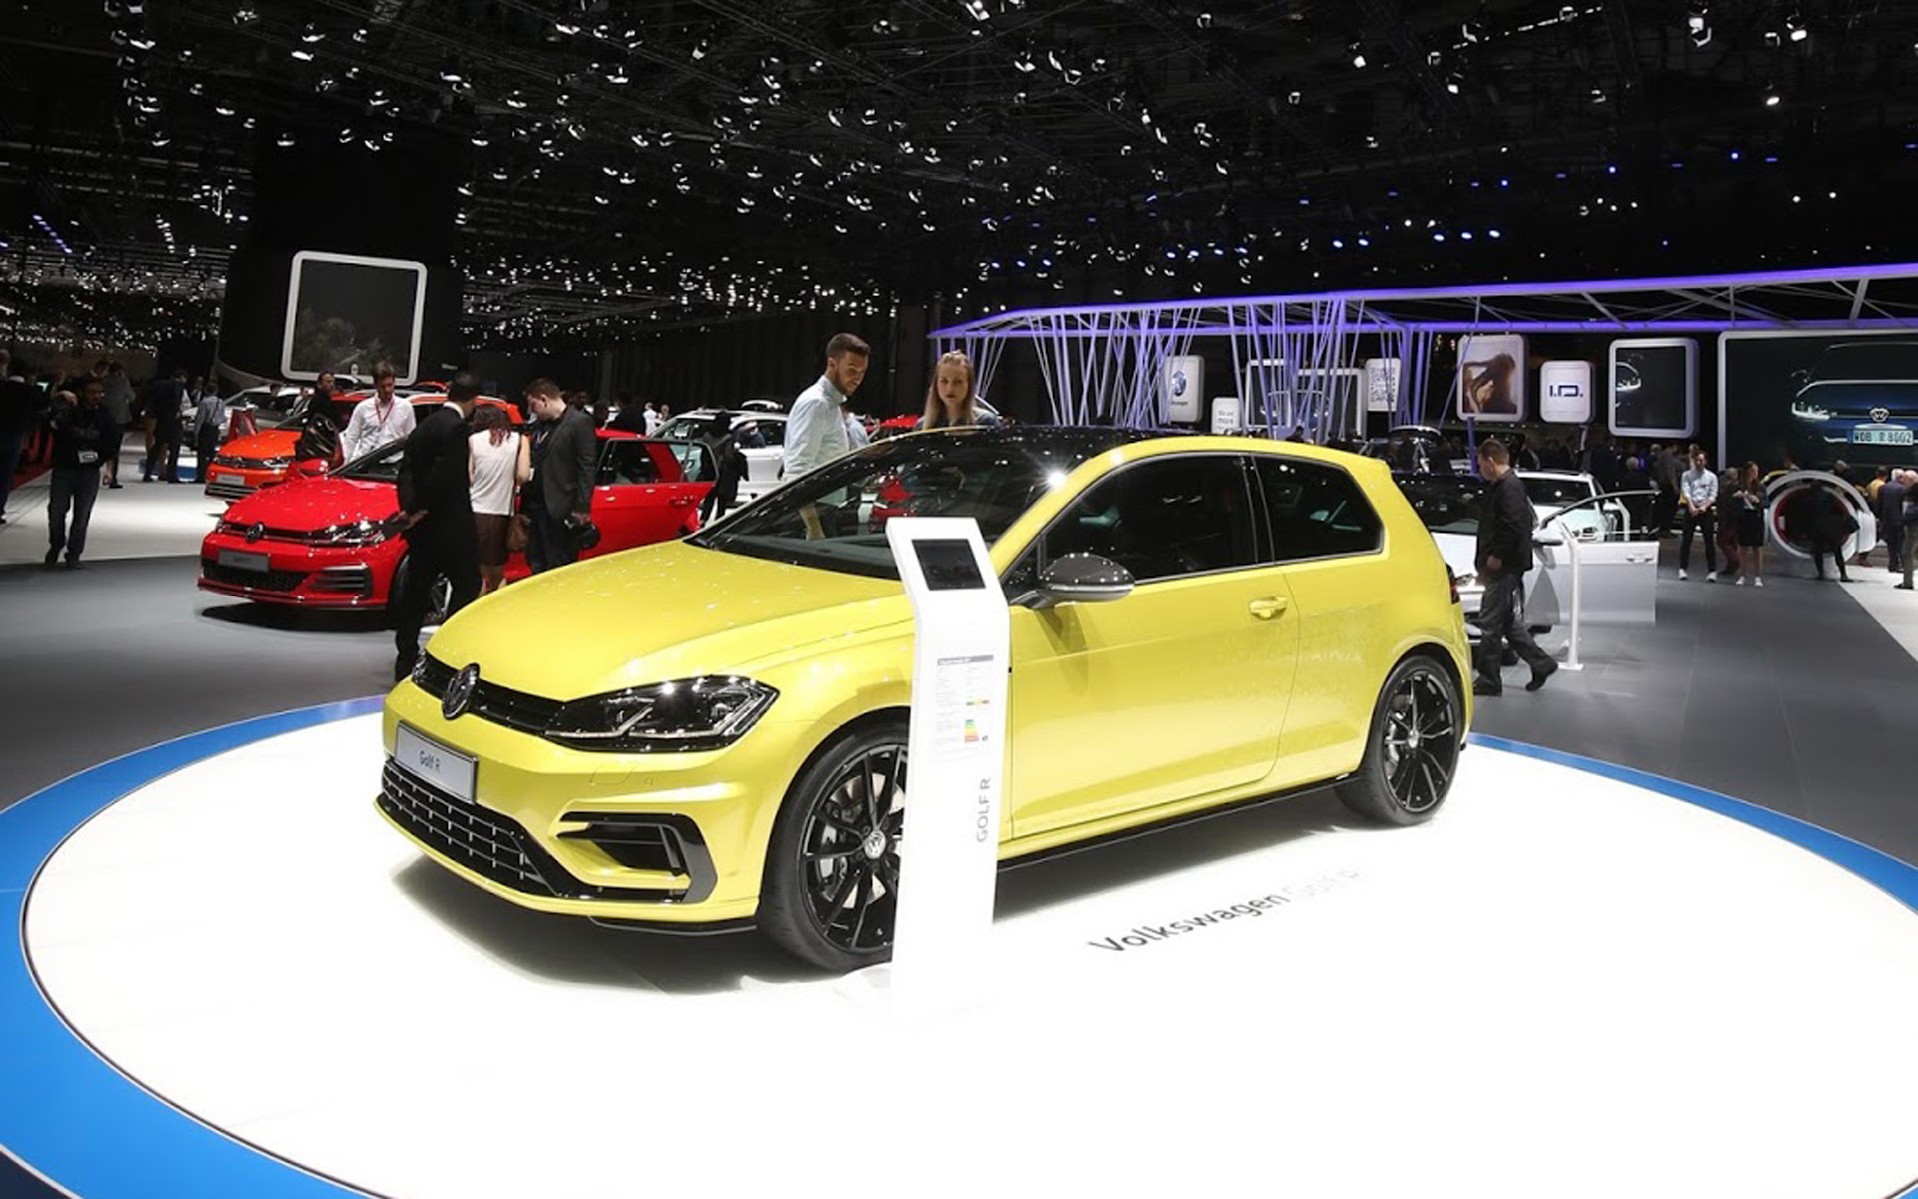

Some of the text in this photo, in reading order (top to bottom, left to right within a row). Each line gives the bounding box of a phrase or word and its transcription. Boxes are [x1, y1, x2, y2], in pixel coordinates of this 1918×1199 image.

[1550, 384, 1584, 397] I.D.
[976, 777, 992, 844] GOLF R
[1087, 893, 1291, 952] Volkswagen
